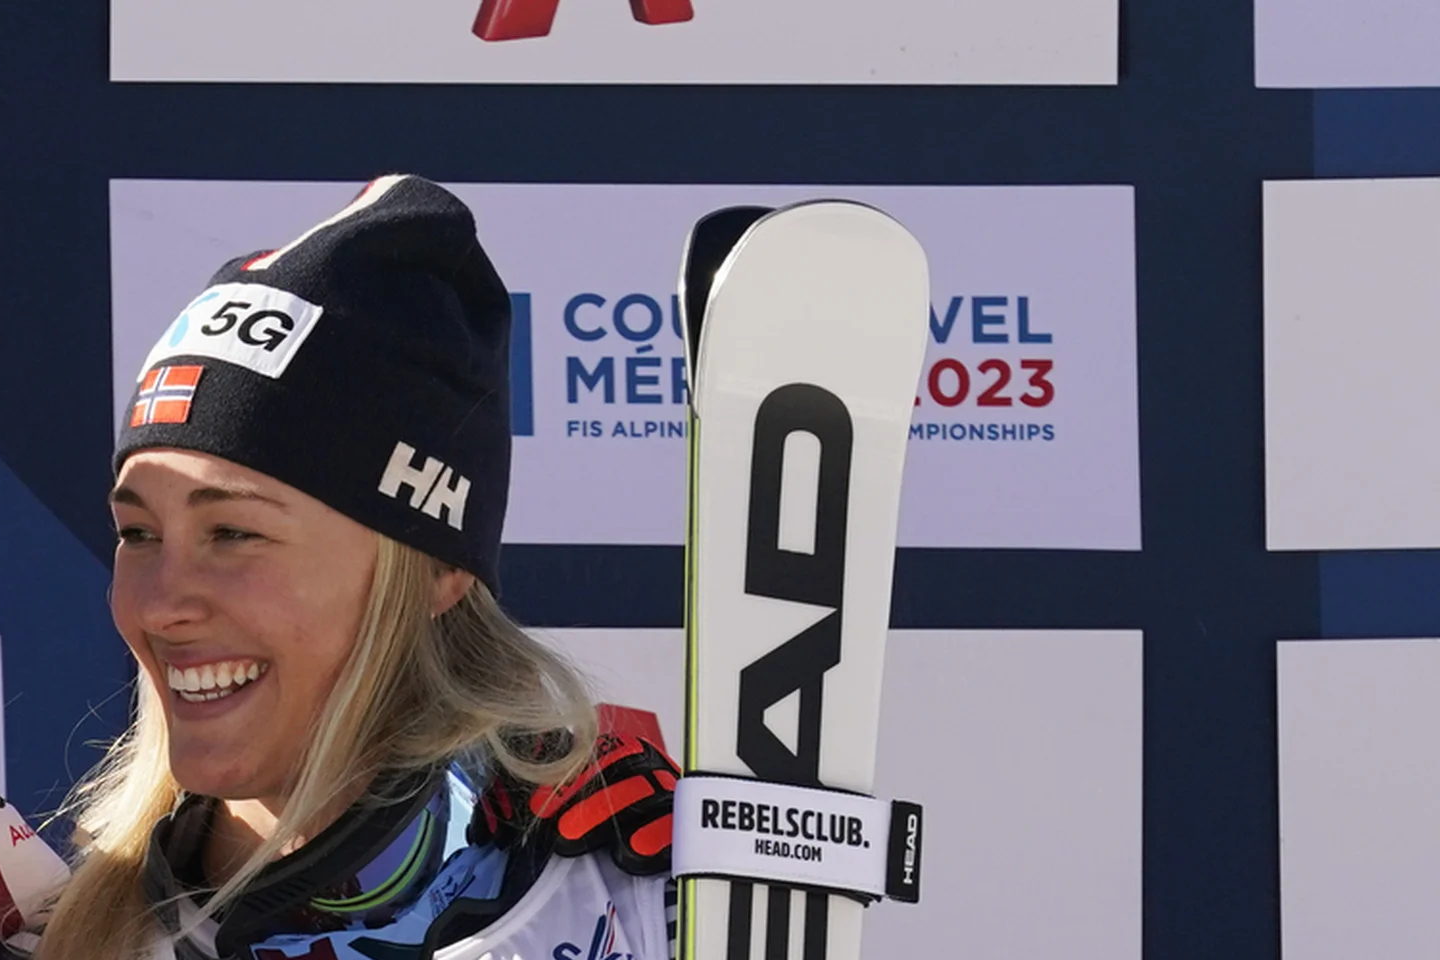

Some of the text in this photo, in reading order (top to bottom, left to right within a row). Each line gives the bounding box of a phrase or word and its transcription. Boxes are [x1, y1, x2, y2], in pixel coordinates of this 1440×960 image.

[201, 301, 294, 352] 5G
[914, 358, 1055, 408] 023
[567, 421, 1055, 441] FIS ALPIN MPIONSHIPS
[378, 440, 471, 531] HH
[701, 798, 870, 849] REBELSCLUB.
[903, 813, 918, 885] HEAD
[754, 838, 823, 863] HEAD.COM
